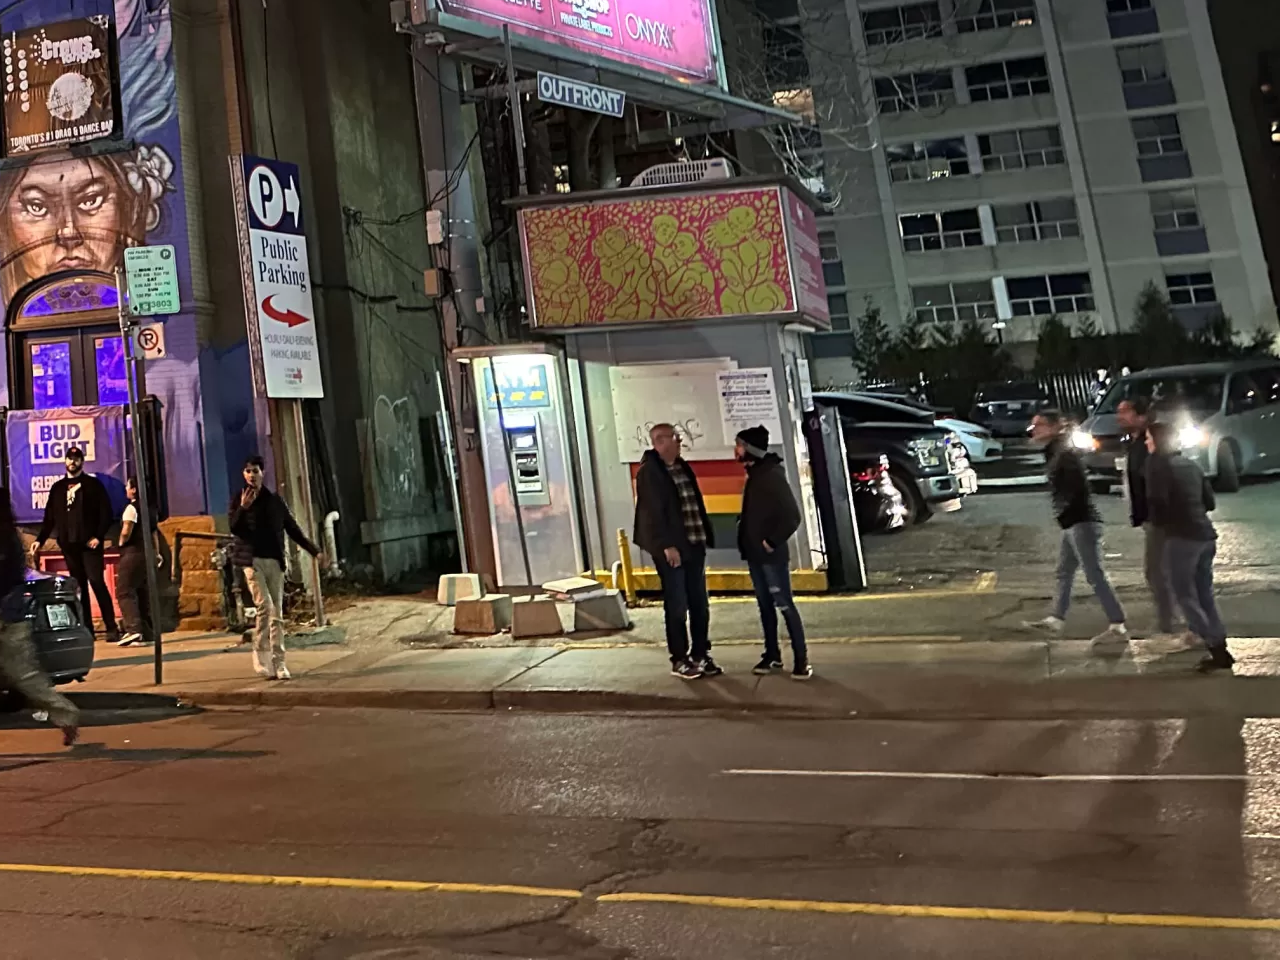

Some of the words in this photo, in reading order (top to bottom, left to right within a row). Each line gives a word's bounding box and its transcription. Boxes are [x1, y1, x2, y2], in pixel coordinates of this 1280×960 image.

[540, 76, 621, 113] OUTFRONT
[11, 132, 45, 147] TORONTO'S
[55, 128, 72, 139] DRAG
[79, 122, 99, 135] DANCE
[261, 236, 298, 262] Public
[258, 260, 307, 293] Parking
[40, 424, 81, 442] BUD
